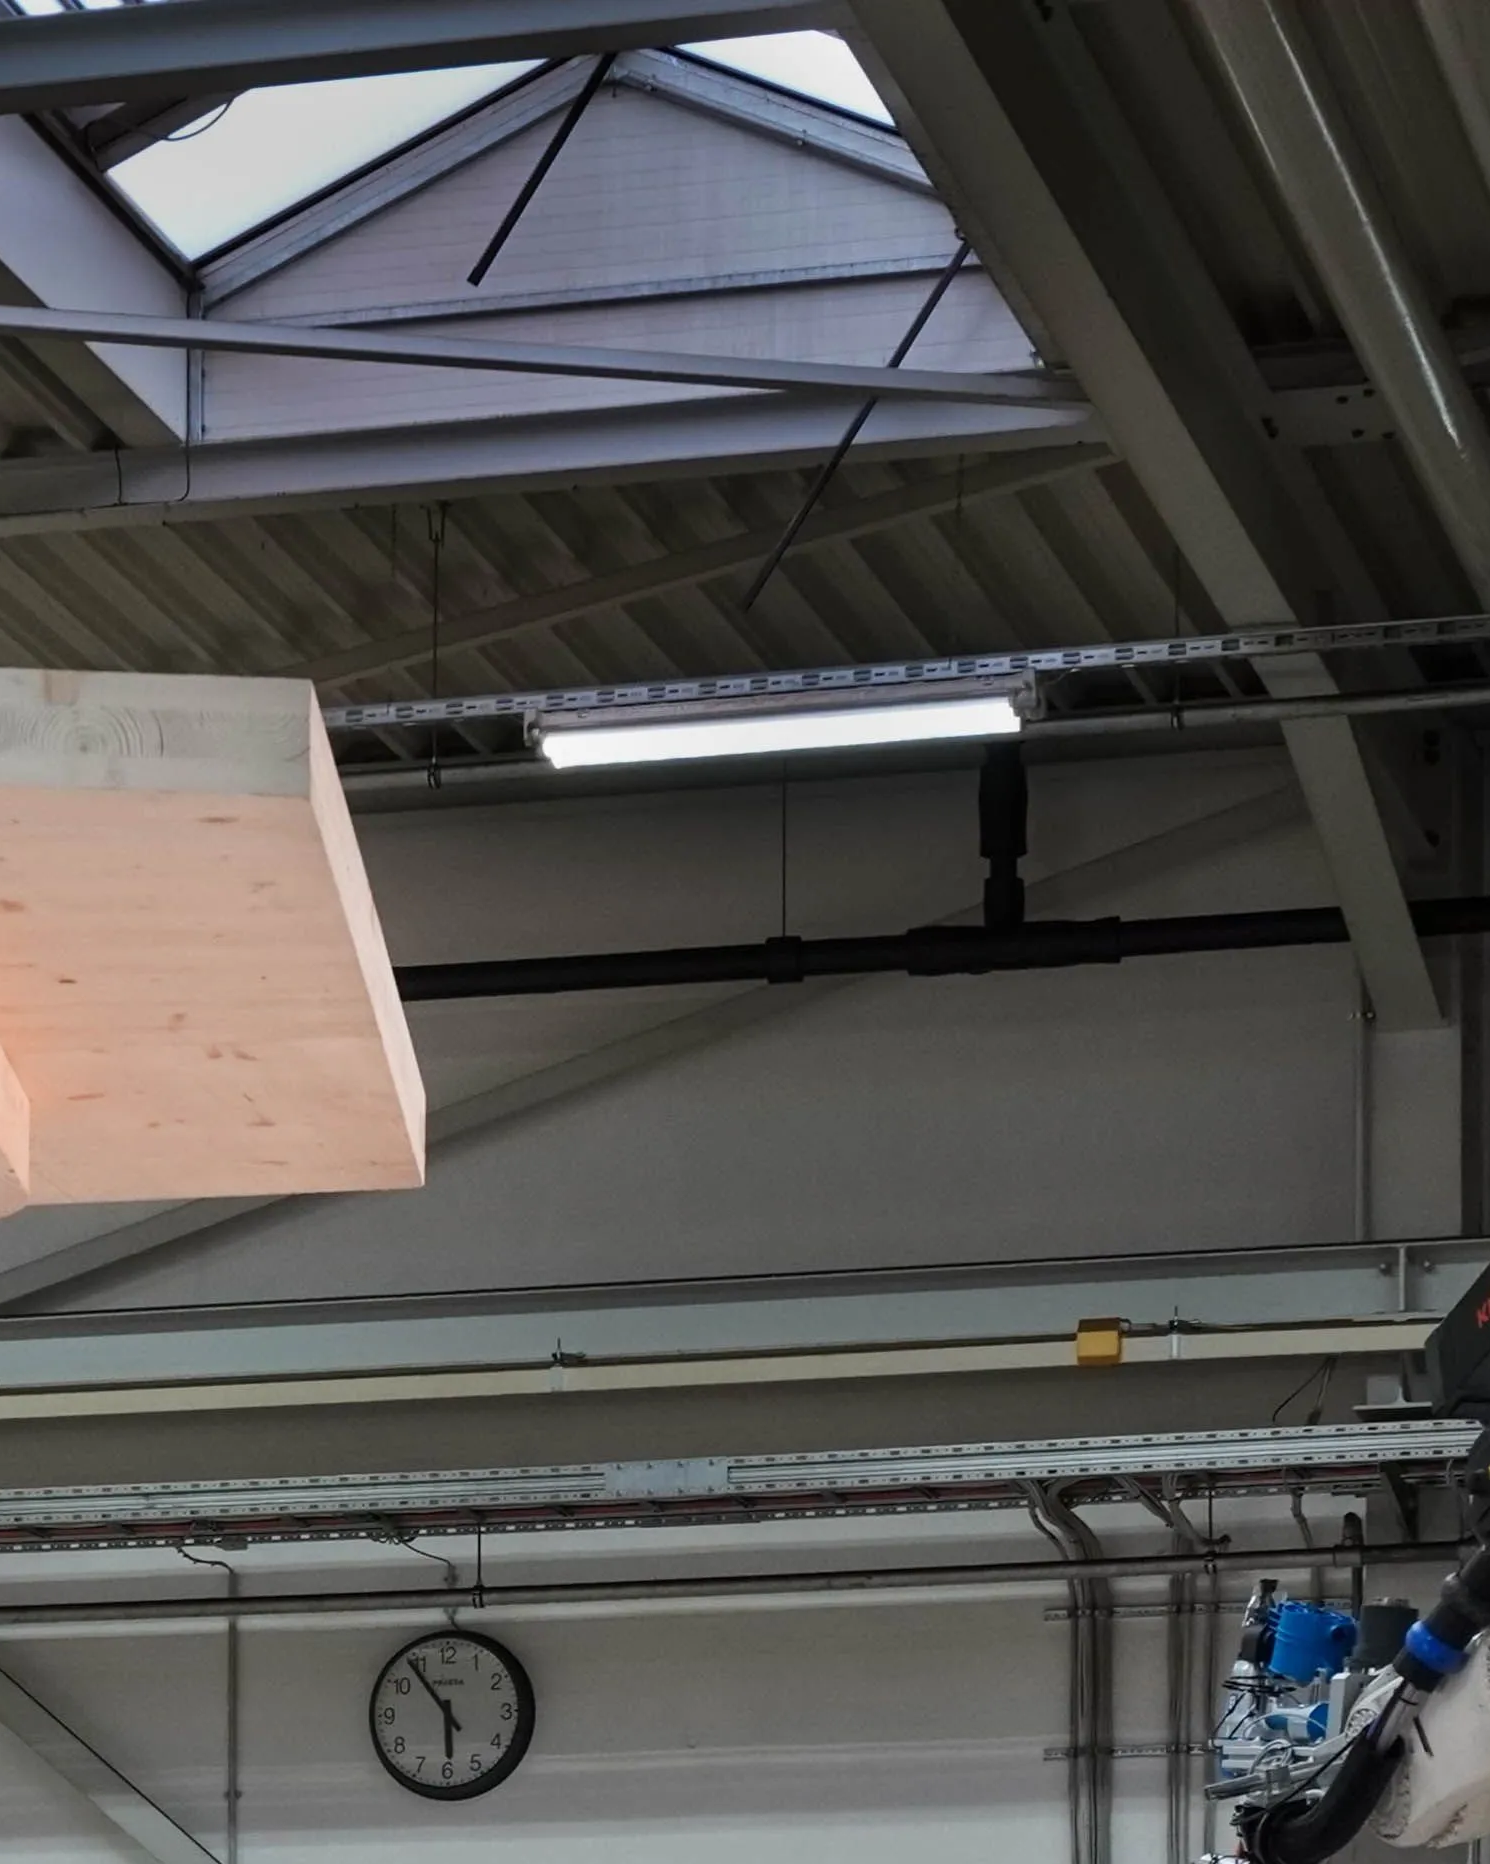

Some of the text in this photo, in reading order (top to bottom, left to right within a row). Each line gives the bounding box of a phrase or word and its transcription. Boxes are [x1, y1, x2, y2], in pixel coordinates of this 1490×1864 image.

[439, 1646, 457, 1665] 12
[473, 1654, 479, 1672] 1
[393, 1676, 411, 1695] 10
[490, 1672, 503, 1691] 2
[383, 1707, 395, 1725] 9
[500, 1702, 513, 1721] 3
[393, 1736, 406, 1754] 8
[490, 1733, 501, 1749] 4
[415, 1756, 426, 1773] 7
[441, 1761, 454, 1779] 6
[470, 1753, 482, 1772] 5
